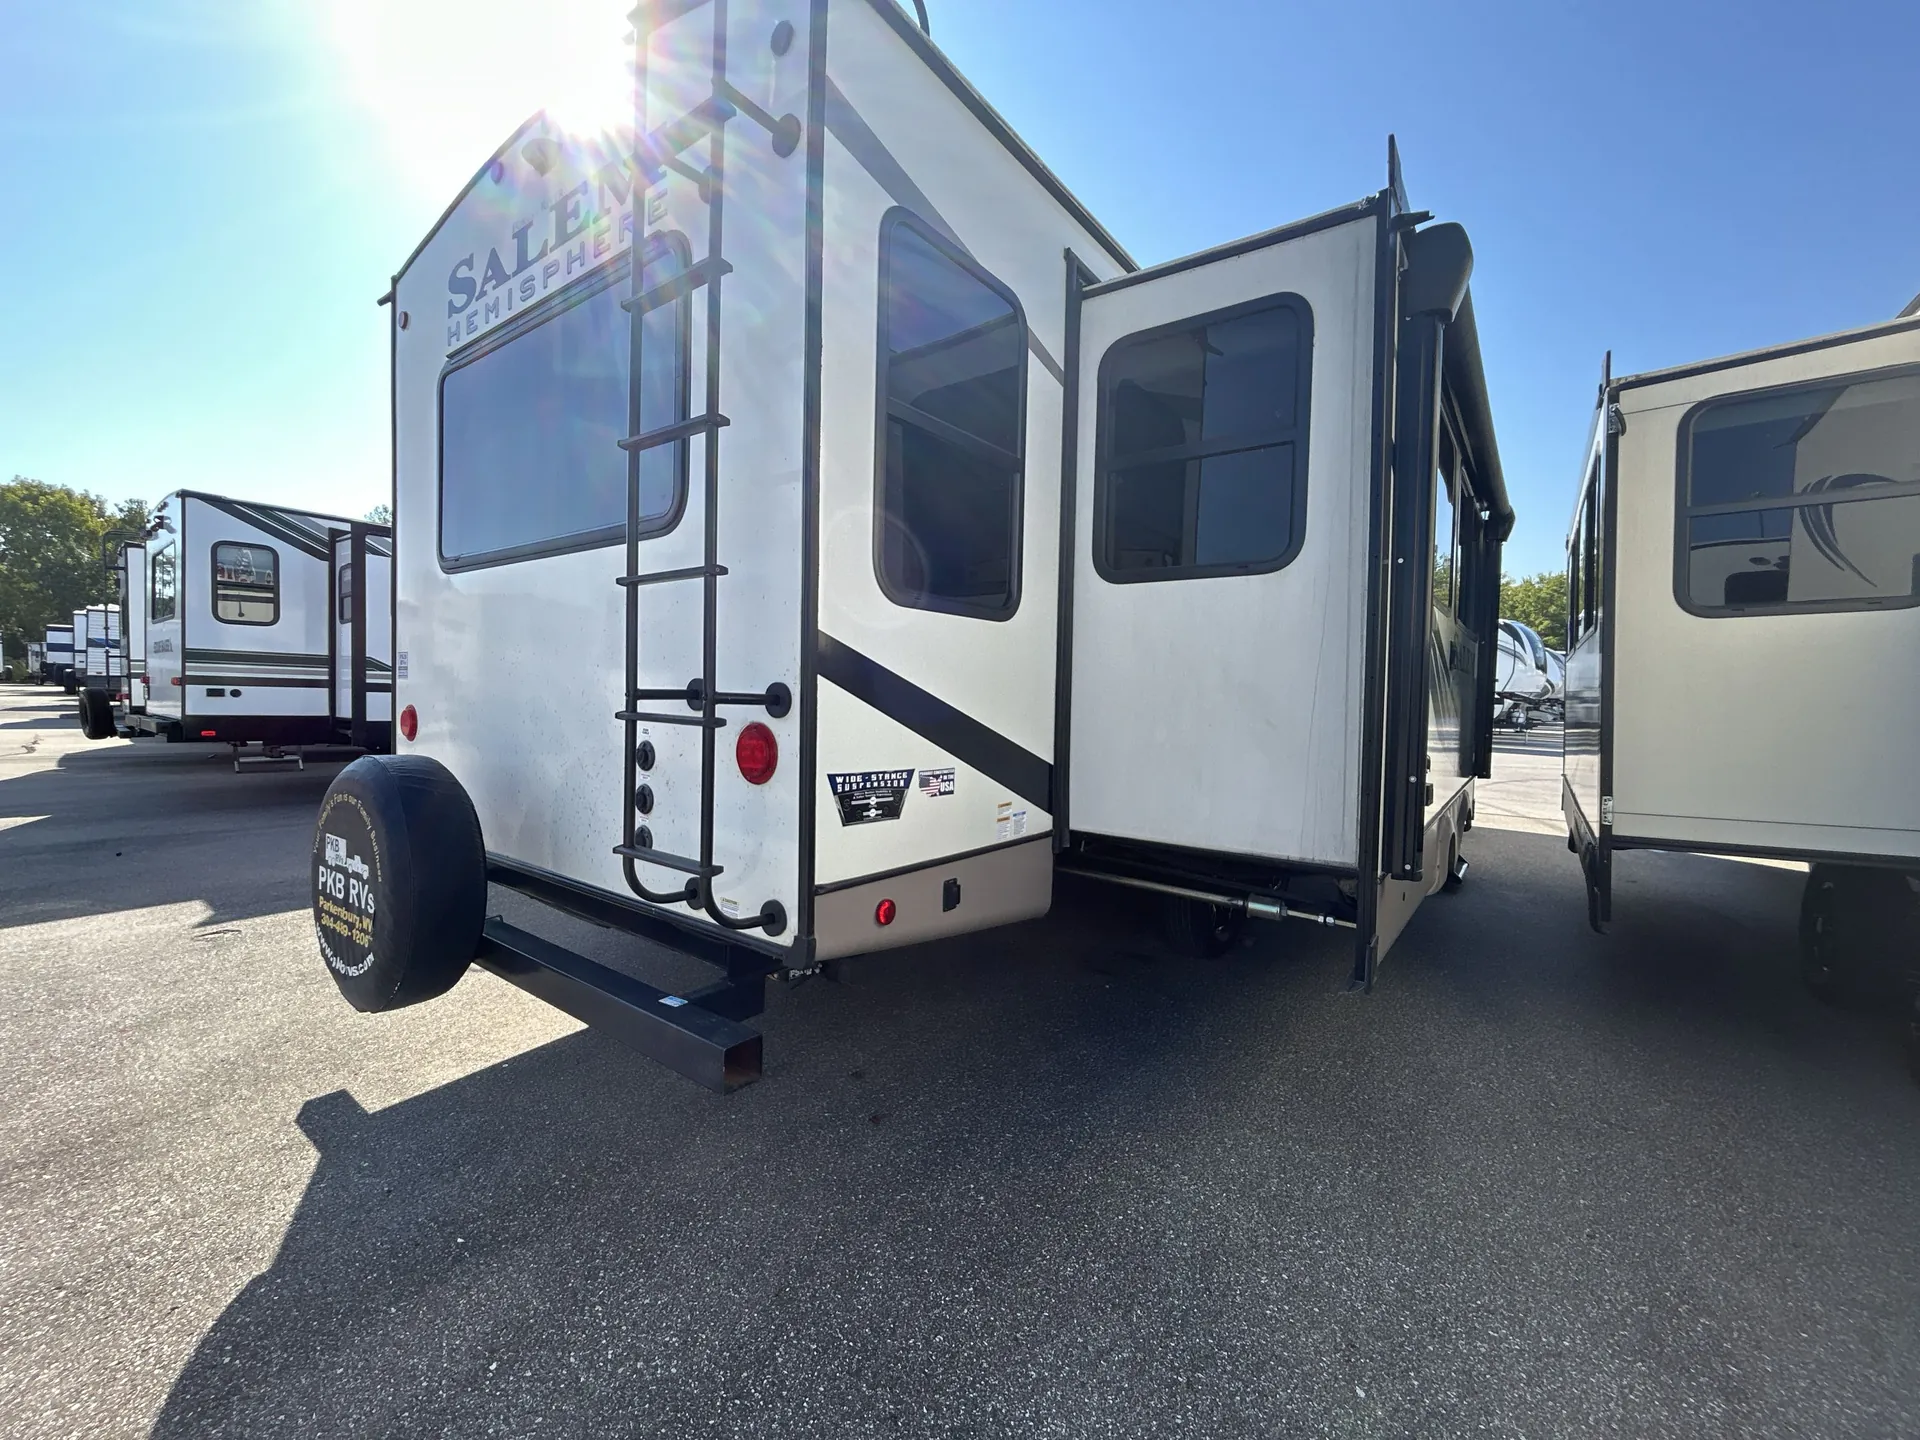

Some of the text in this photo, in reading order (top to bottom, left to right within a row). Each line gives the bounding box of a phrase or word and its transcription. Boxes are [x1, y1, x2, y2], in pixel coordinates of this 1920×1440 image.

[447, 121, 668, 319] SALEM
[447, 188, 668, 346] HEMISPHERE
[837, 779, 904, 793] SUSPENSION
[940, 780, 954, 792] USA
[326, 835, 340, 853] PKB
[318, 865, 375, 914] PKB RVs
